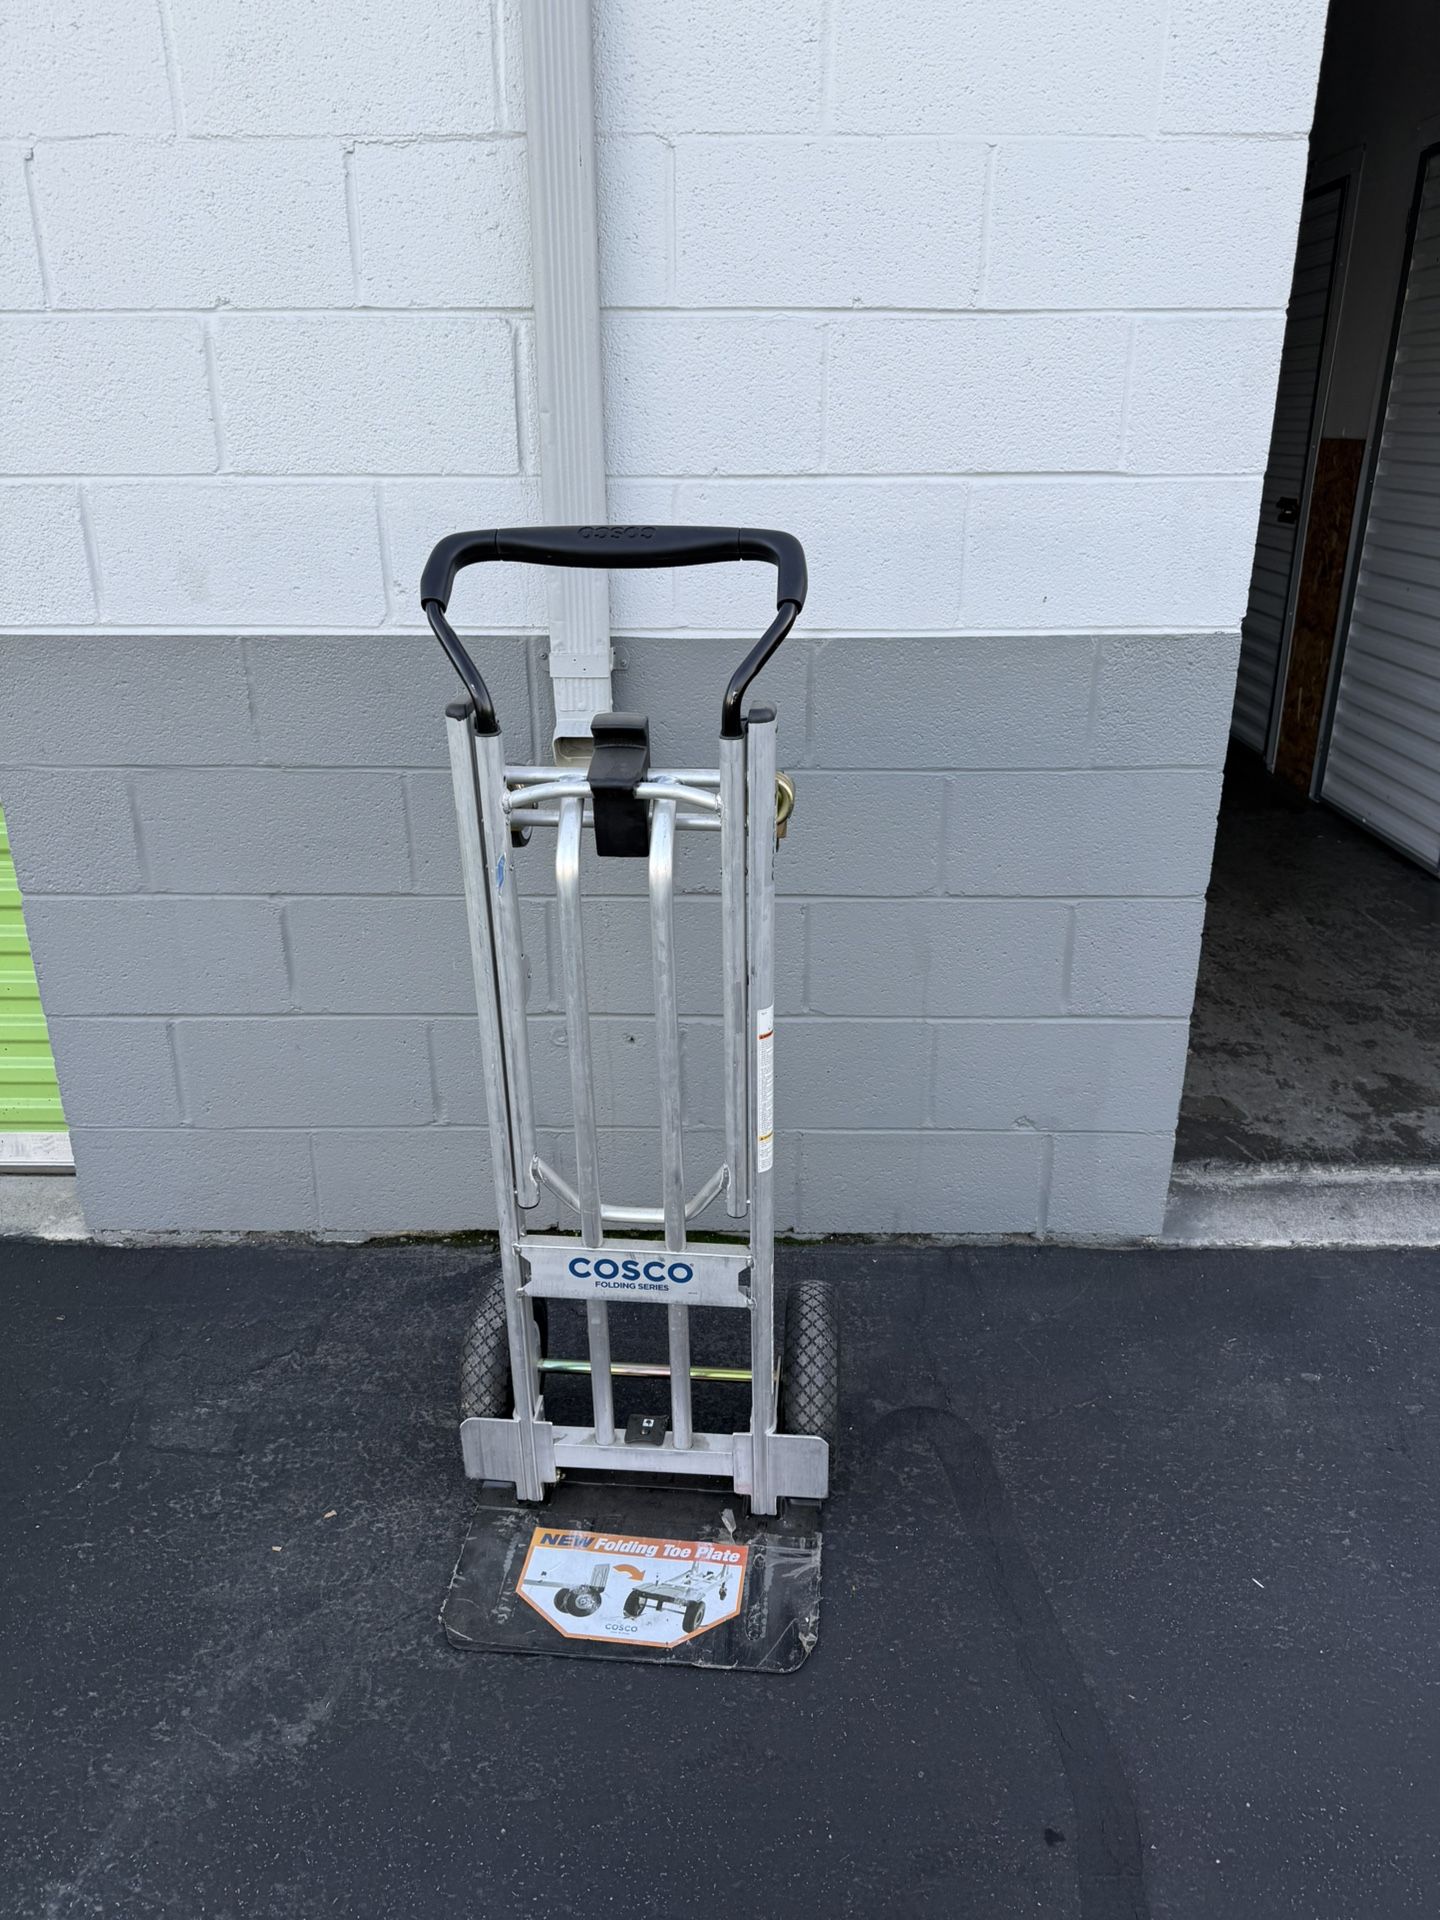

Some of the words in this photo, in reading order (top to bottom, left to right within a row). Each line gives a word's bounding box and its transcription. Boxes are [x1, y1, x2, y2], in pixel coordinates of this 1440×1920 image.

[578, 526, 656, 539] COSCO
[569, 1258, 693, 1284] COSCO
[595, 1281, 636, 1290] FOLDING
[638, 1282, 669, 1291] SERIES
[540, 1533, 595, 1548] NEW
[594, 1537, 658, 1557] Folding
[663, 1543, 689, 1558] Toe
[694, 1545, 741, 1563] Plate
[605, 1623, 638, 1632] COSCO
